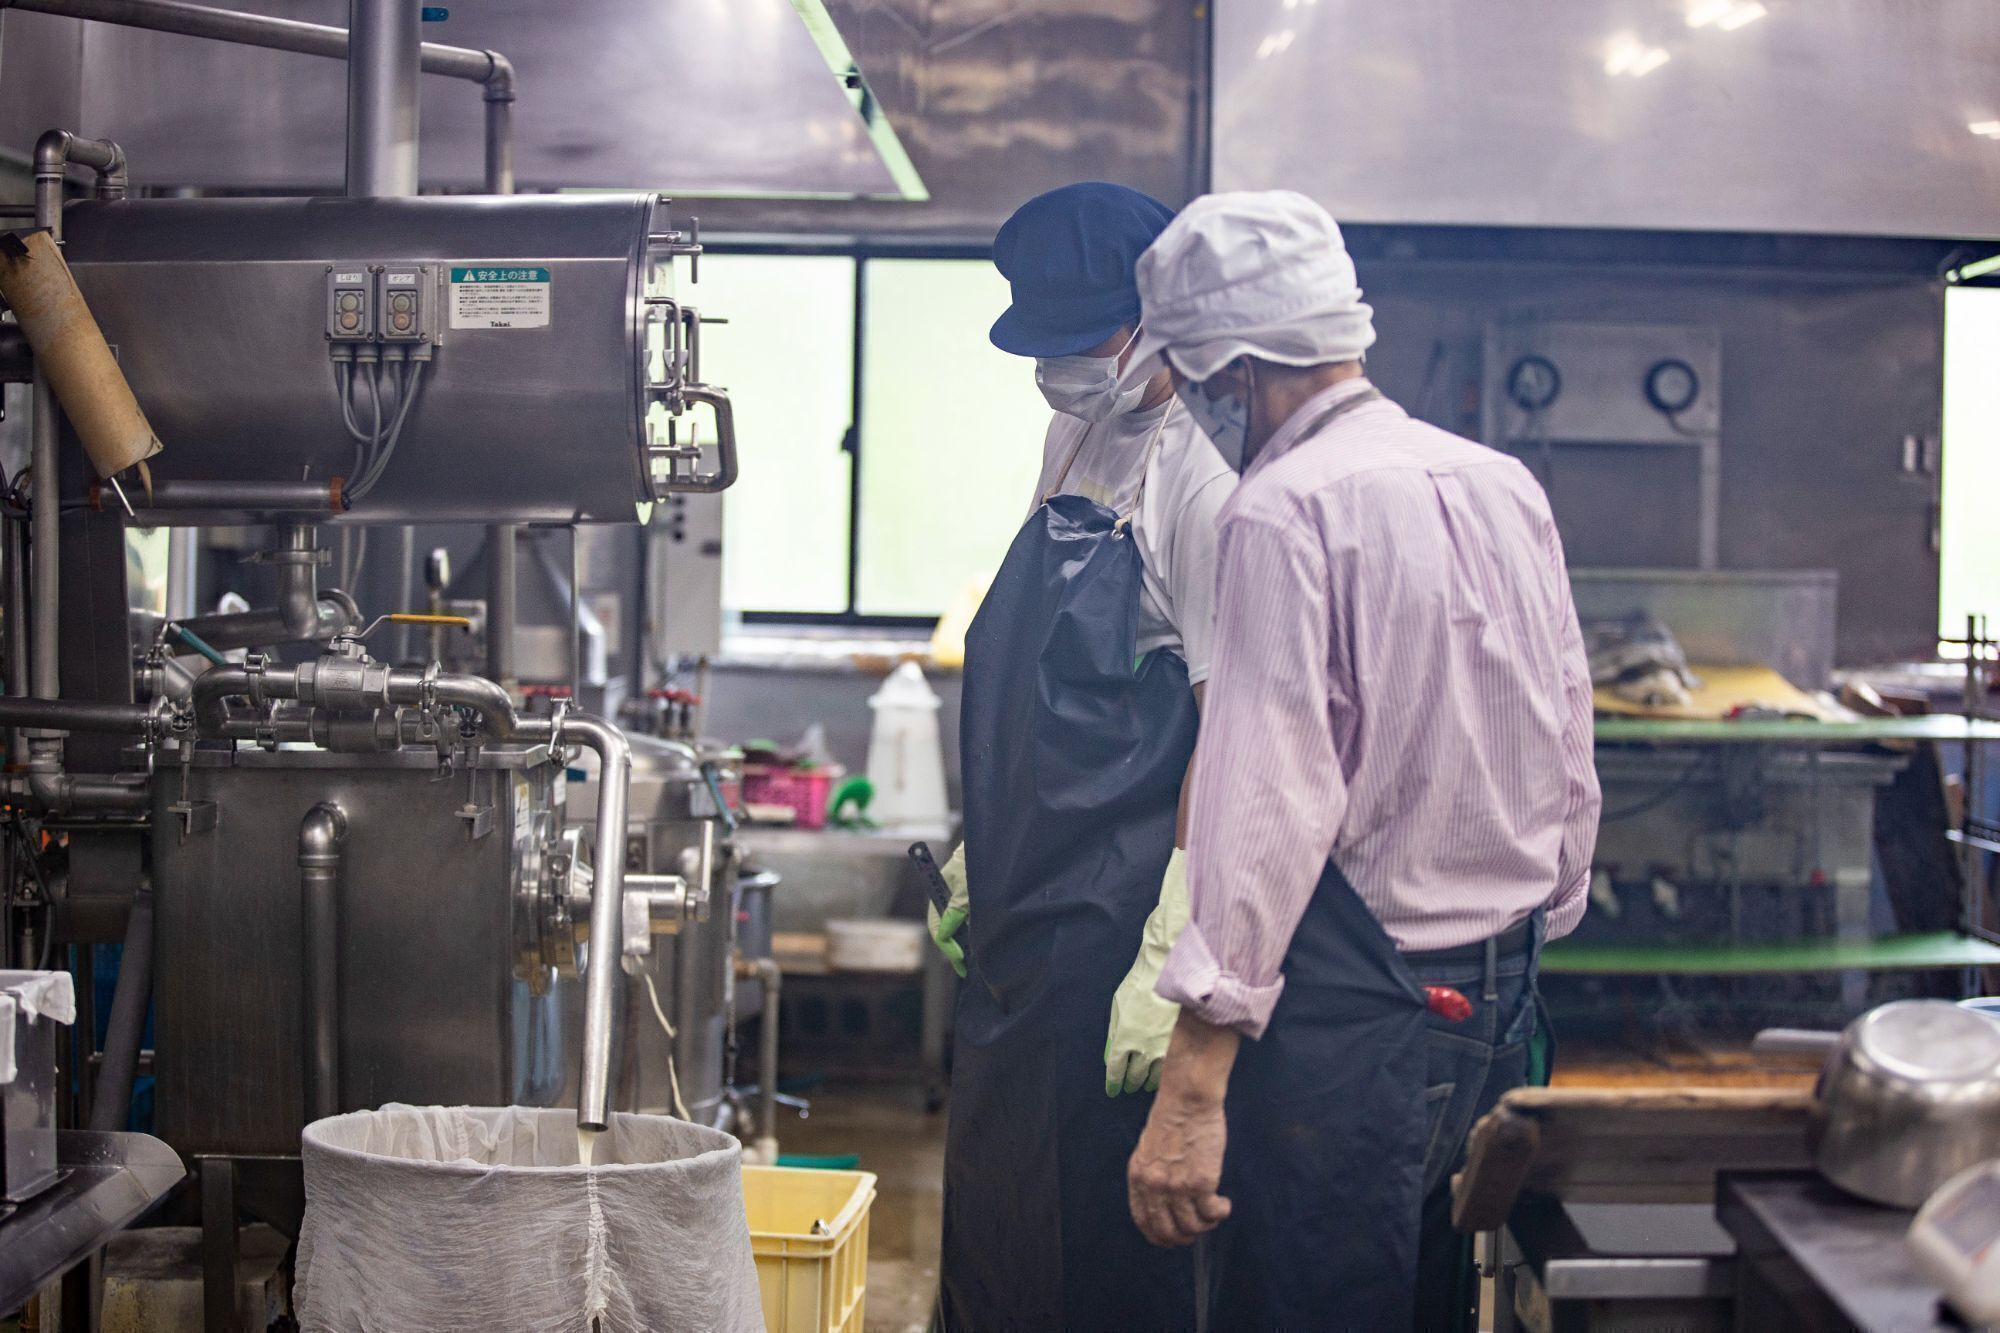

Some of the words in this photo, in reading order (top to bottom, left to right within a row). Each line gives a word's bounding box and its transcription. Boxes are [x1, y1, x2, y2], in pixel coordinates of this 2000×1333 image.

[478, 270, 538, 281] 安全上の注意
